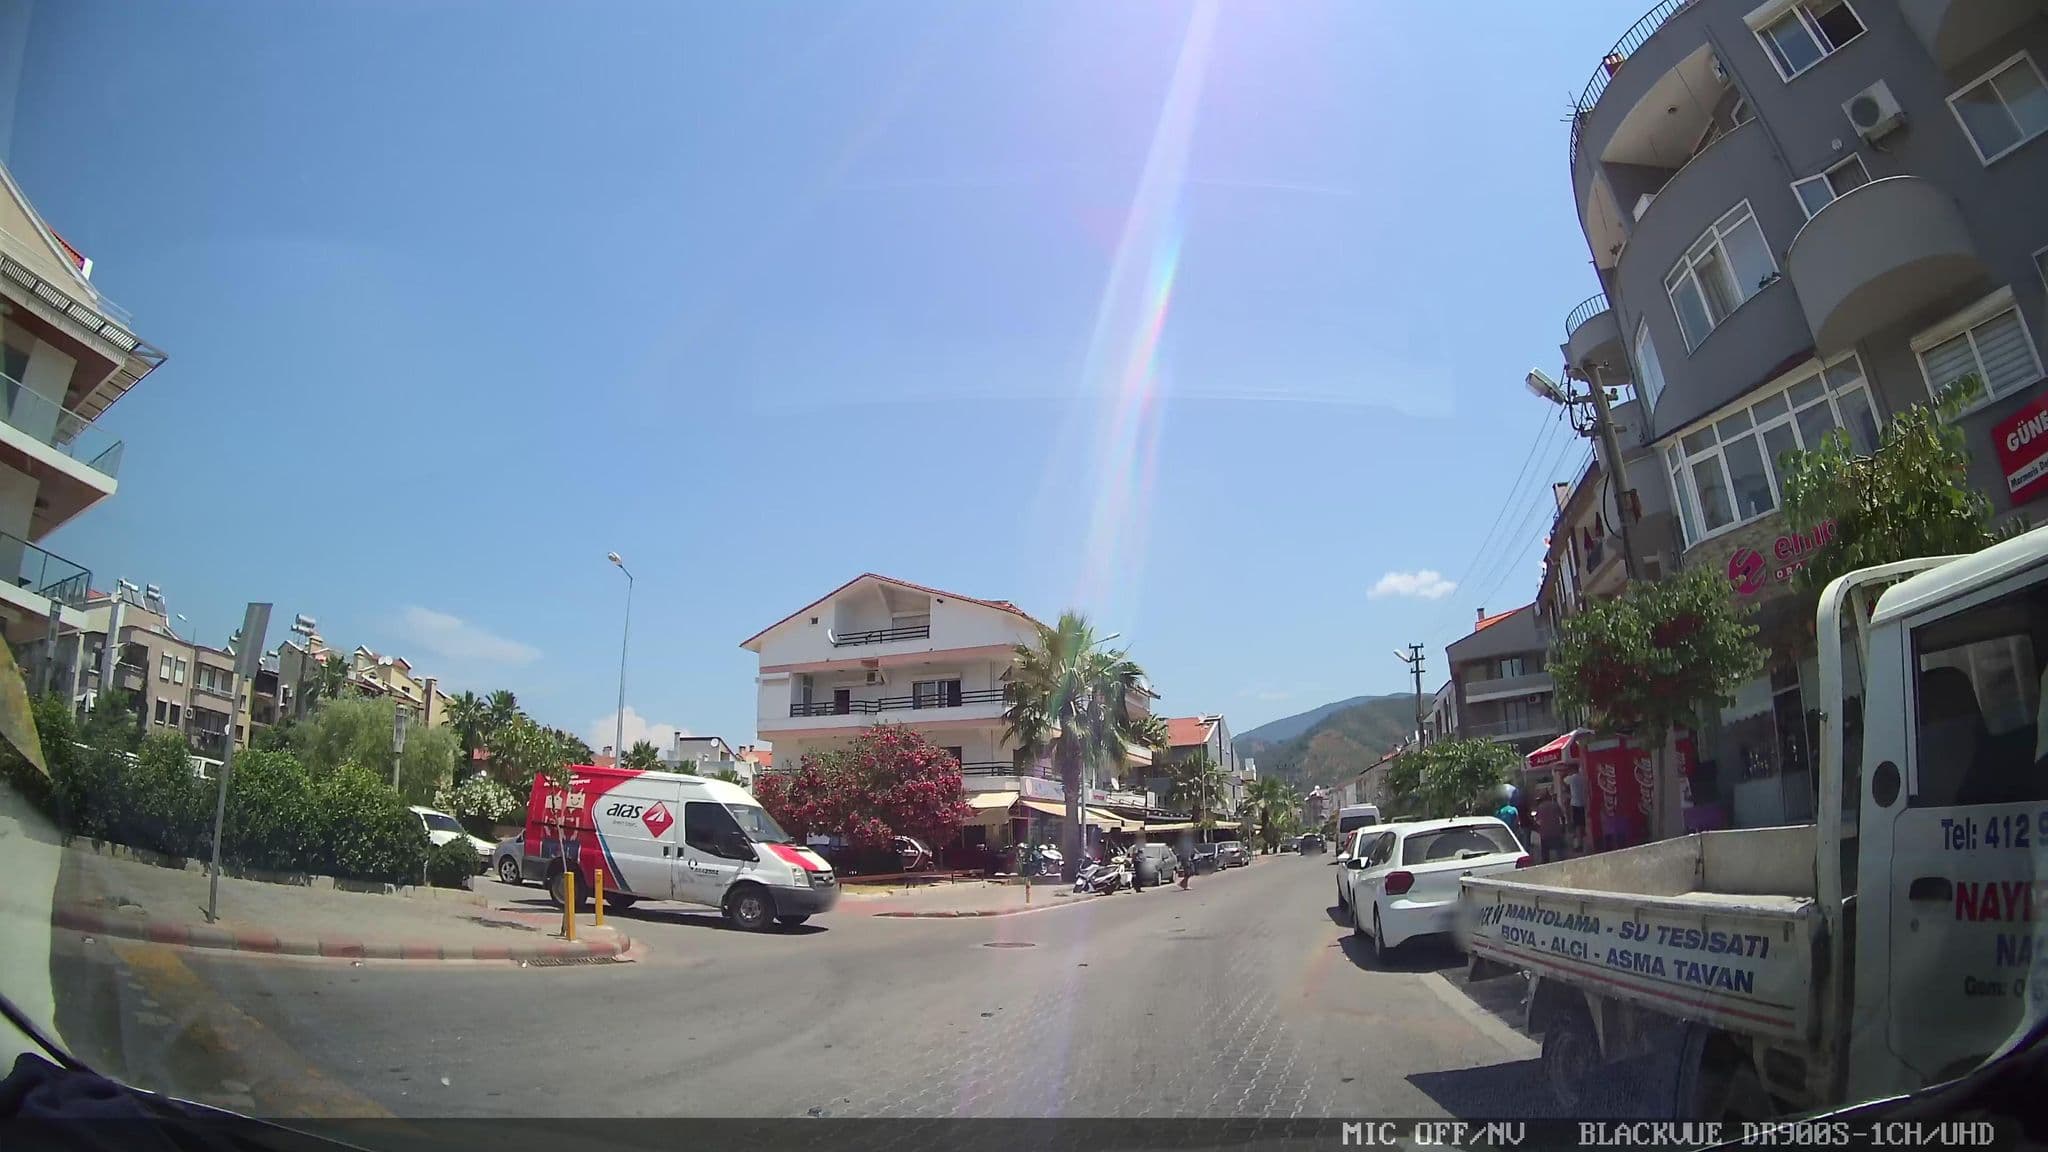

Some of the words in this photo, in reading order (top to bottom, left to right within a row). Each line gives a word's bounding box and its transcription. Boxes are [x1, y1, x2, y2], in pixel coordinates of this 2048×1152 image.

[606, 803, 643, 819] aras
[1941, 818, 1977, 850] Tel:
[1985, 814, 2030, 849] 412
[1504, 902, 1600, 934] MANTOLAMA
[1618, 921, 1650, 942] SU
[1501, 925, 1536, 948] BOYA
[1606, 949, 1666, 977] ASMA
[1674, 960, 1754, 994] TAVAN
